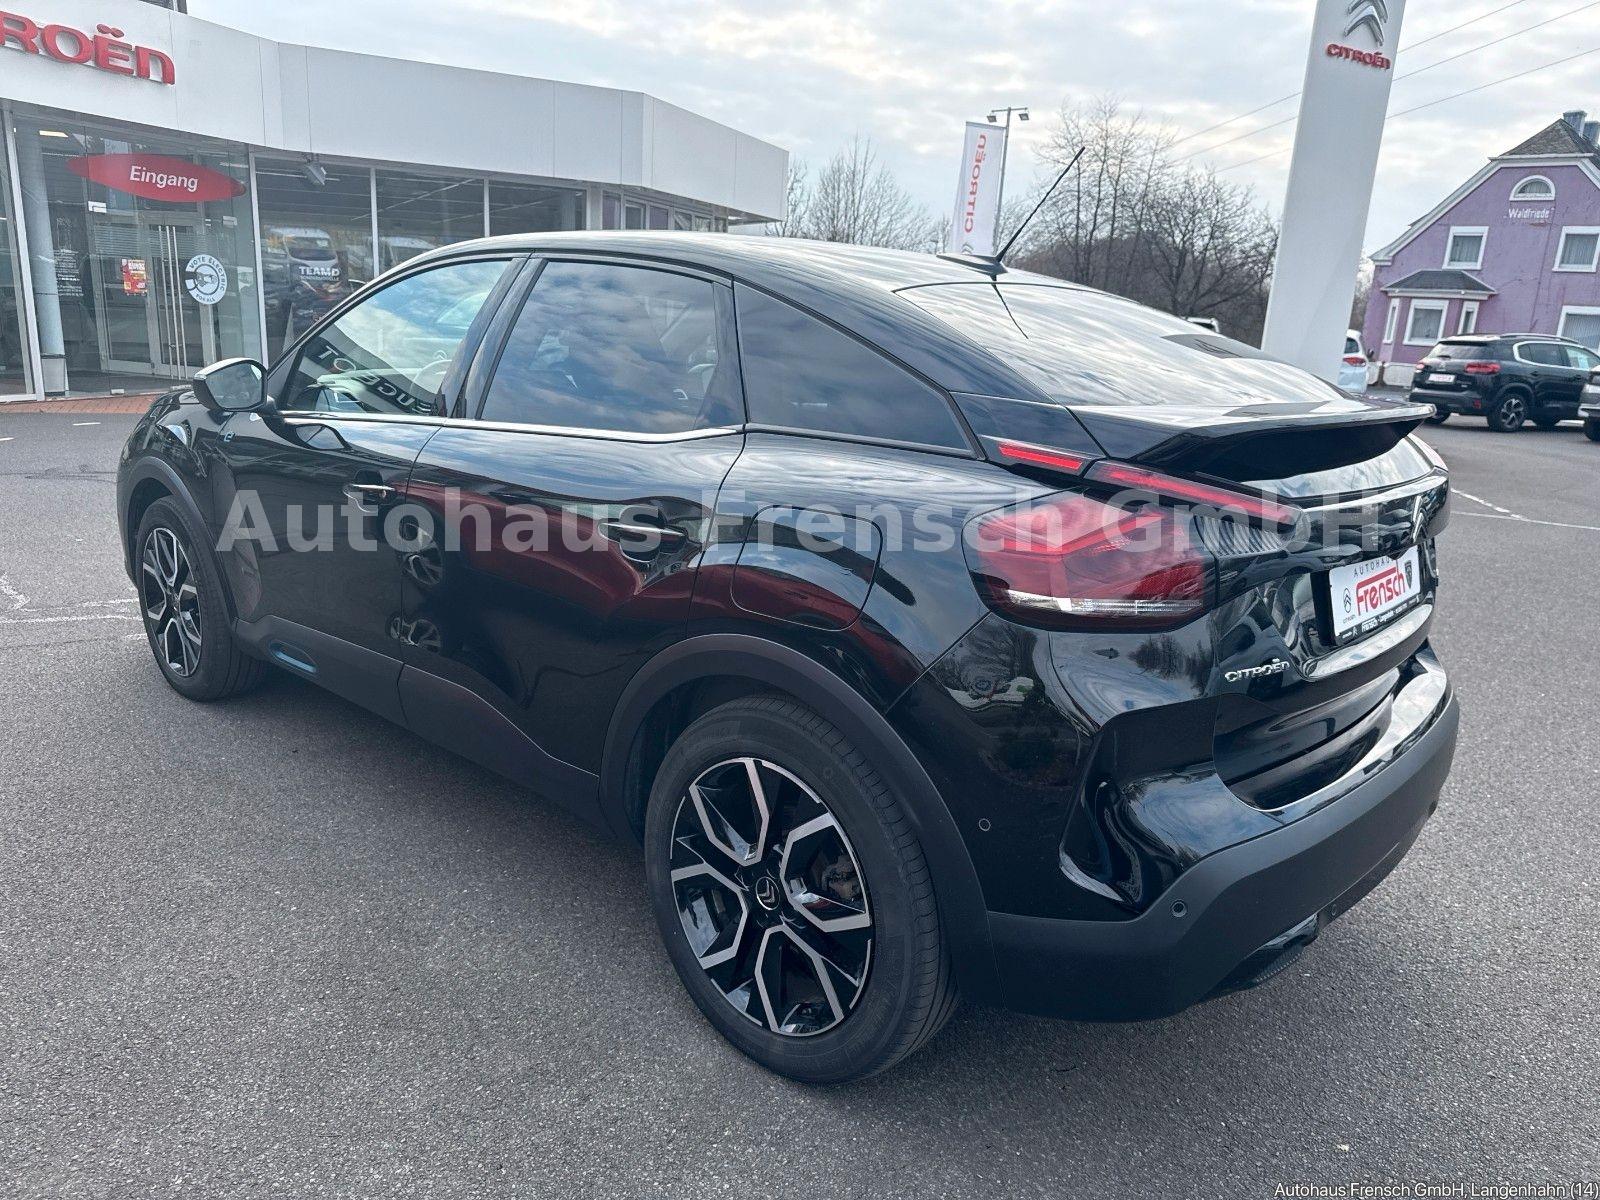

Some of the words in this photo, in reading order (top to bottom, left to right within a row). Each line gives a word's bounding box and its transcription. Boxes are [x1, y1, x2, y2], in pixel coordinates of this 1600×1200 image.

[1326, 44, 1391, 69] CITROËN
[129, 165, 199, 192] Eingang
[964, 134, 987, 233] CITROËN
[190, 256, 206, 269] VOTE
[208, 257, 226, 292] ELECTRIC
[1353, 556, 1393, 578] AUTOHAU
[1356, 560, 1406, 616] Frensch
[1224, 658, 1290, 682] CITROËN
